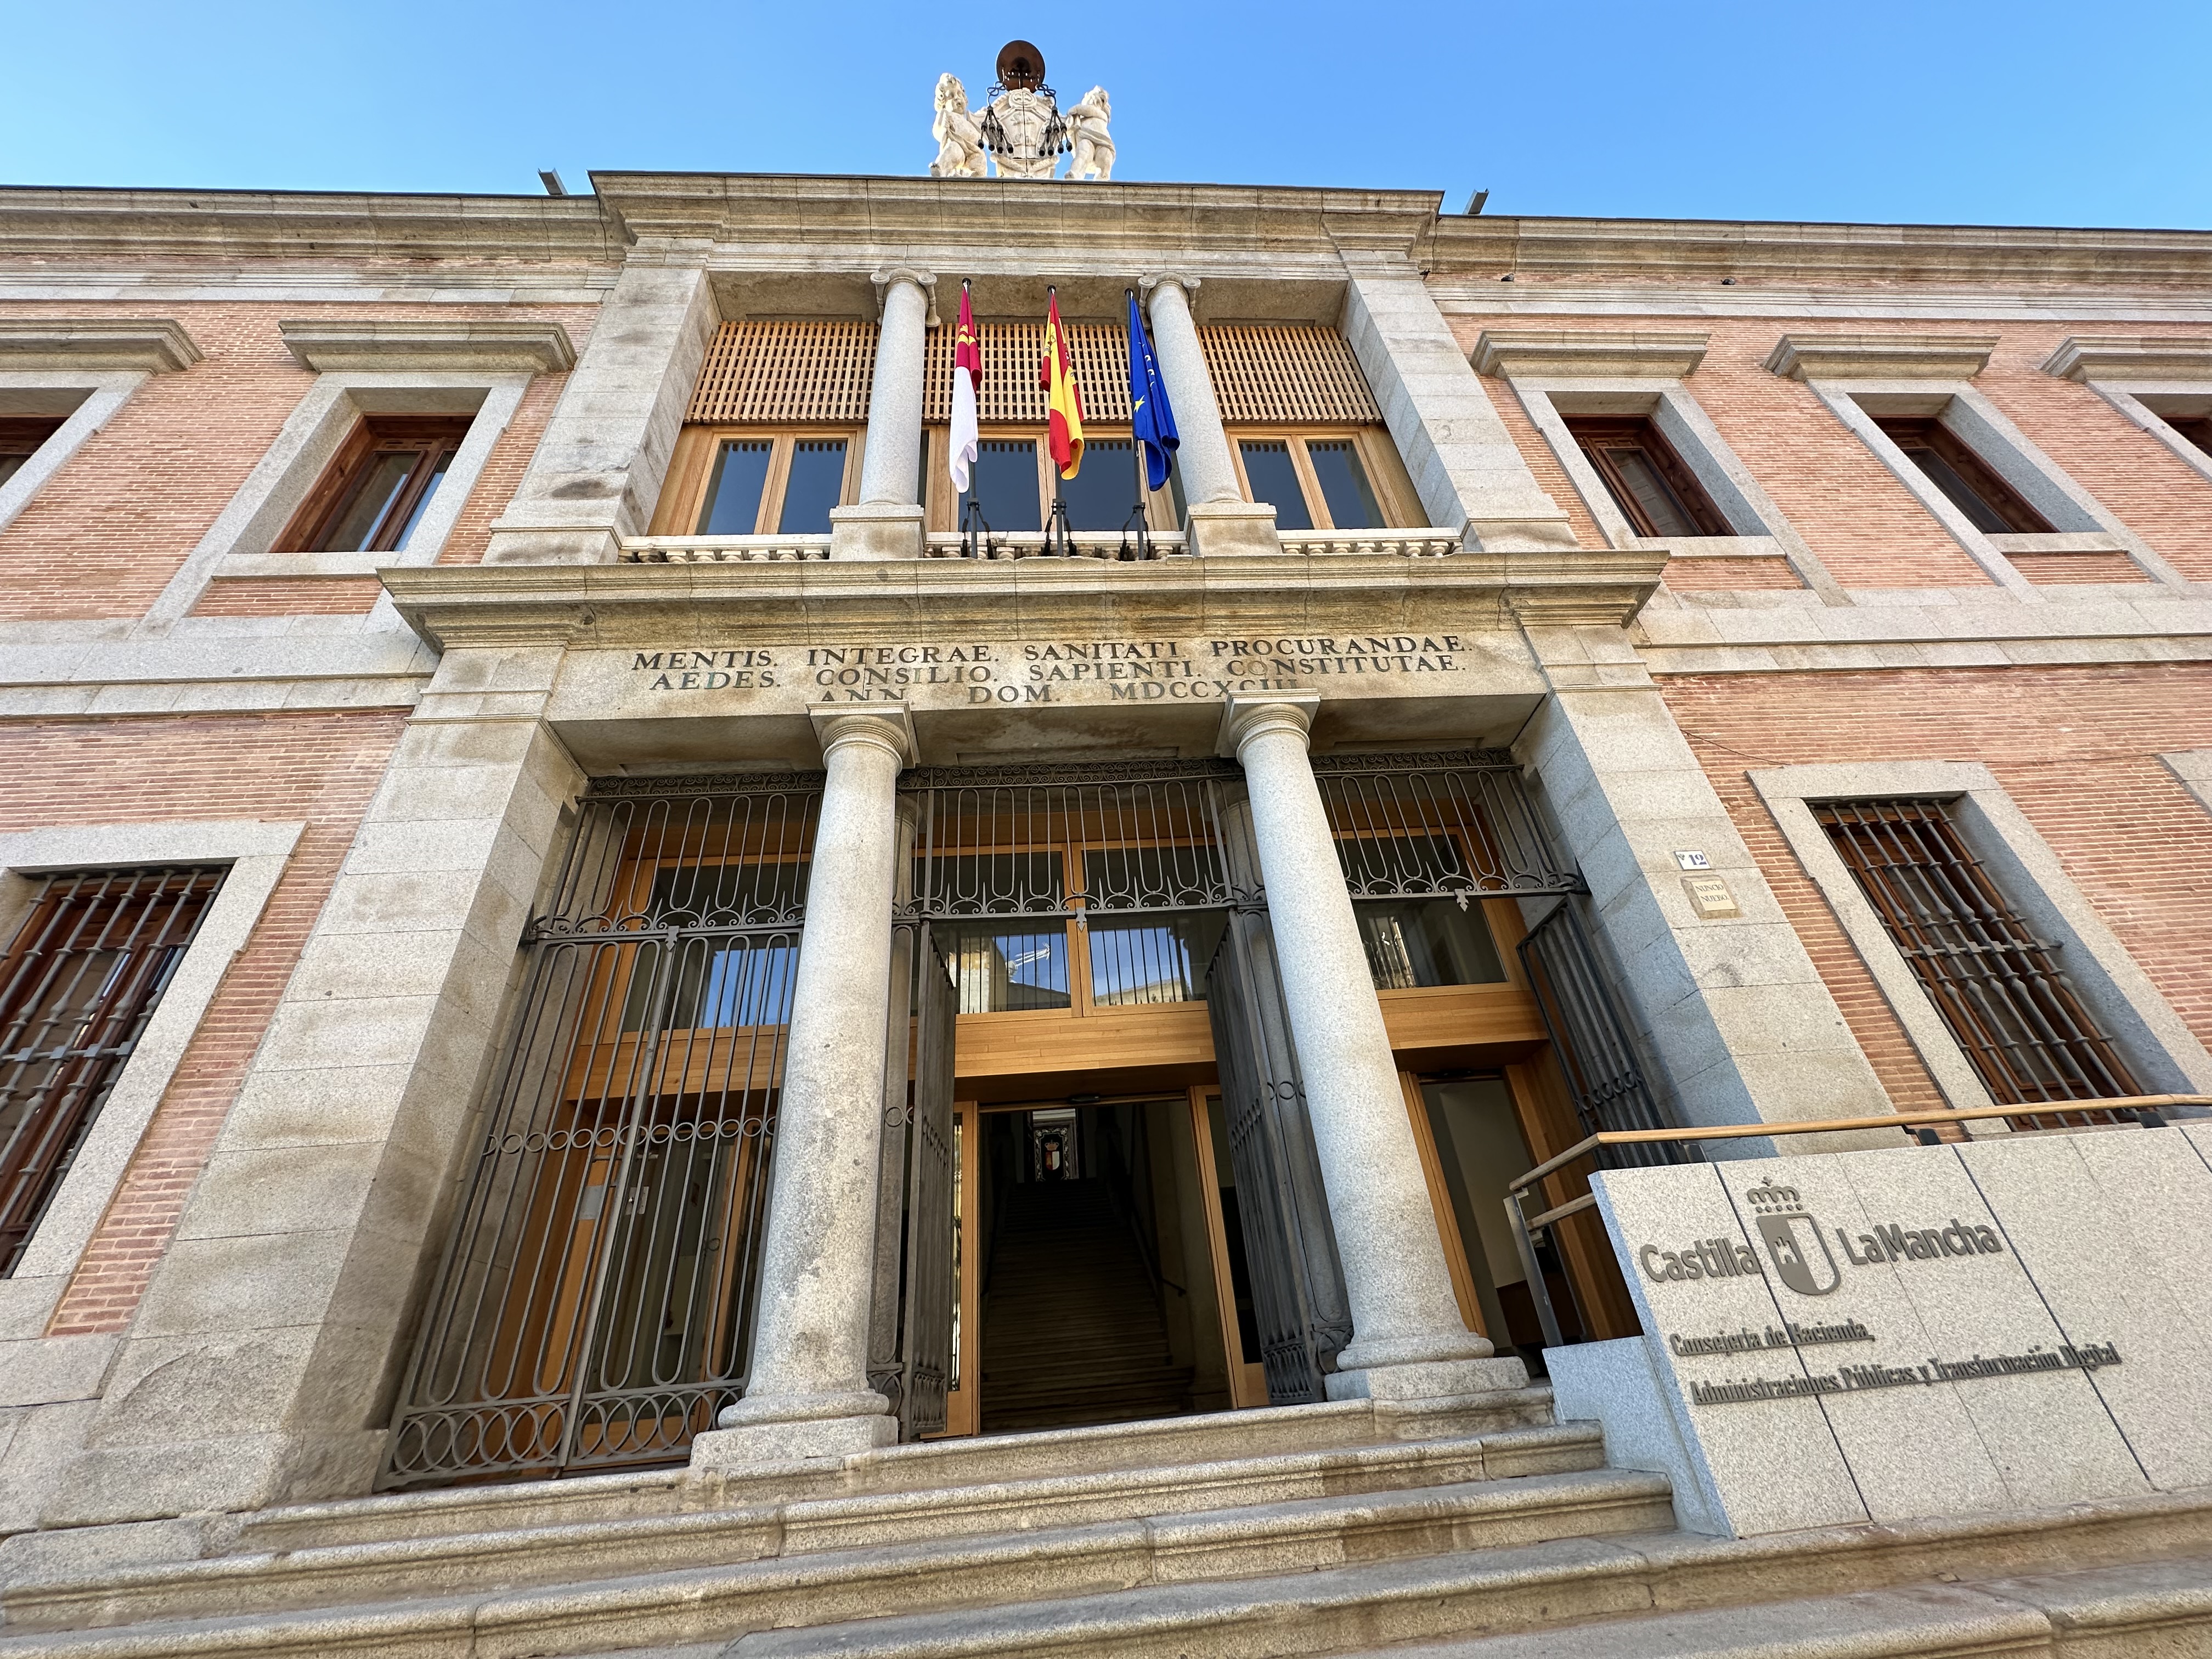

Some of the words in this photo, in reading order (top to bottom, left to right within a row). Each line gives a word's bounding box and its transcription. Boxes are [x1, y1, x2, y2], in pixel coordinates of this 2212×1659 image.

[631, 651, 778, 670] MENTIS.
[806, 645, 999, 666] INTEGRAE.
[1211, 635, 1472, 657] PROCURANDAE.
[649, 671, 781, 690] AEDES.
[816, 665, 998, 686] CONSILIO.
[1029, 660, 1201, 681] SAPIENTI.
[1227, 654, 1466, 676] CONSTITUTAE.
[967, 684, 1061, 704] DOM.
[1689, 854, 1707, 865] 12
[1695, 884, 1724, 892] NUNCIO
[1640, 1236, 1762, 1283] Castilla
[1669, 1327, 1763, 1356] Consejería
[1763, 1325, 1788, 1347] de
[1786, 1318, 1876, 1344] Hacienda,
[1690, 1373, 1841, 1406] Administraciones
[1838, 1364, 1914, 1390] Públicas
[1916, 1365, 1932, 1386] y
[1927, 1345, 2063, 1381] Transformación
[2058, 1341, 2123, 1371] Digital
